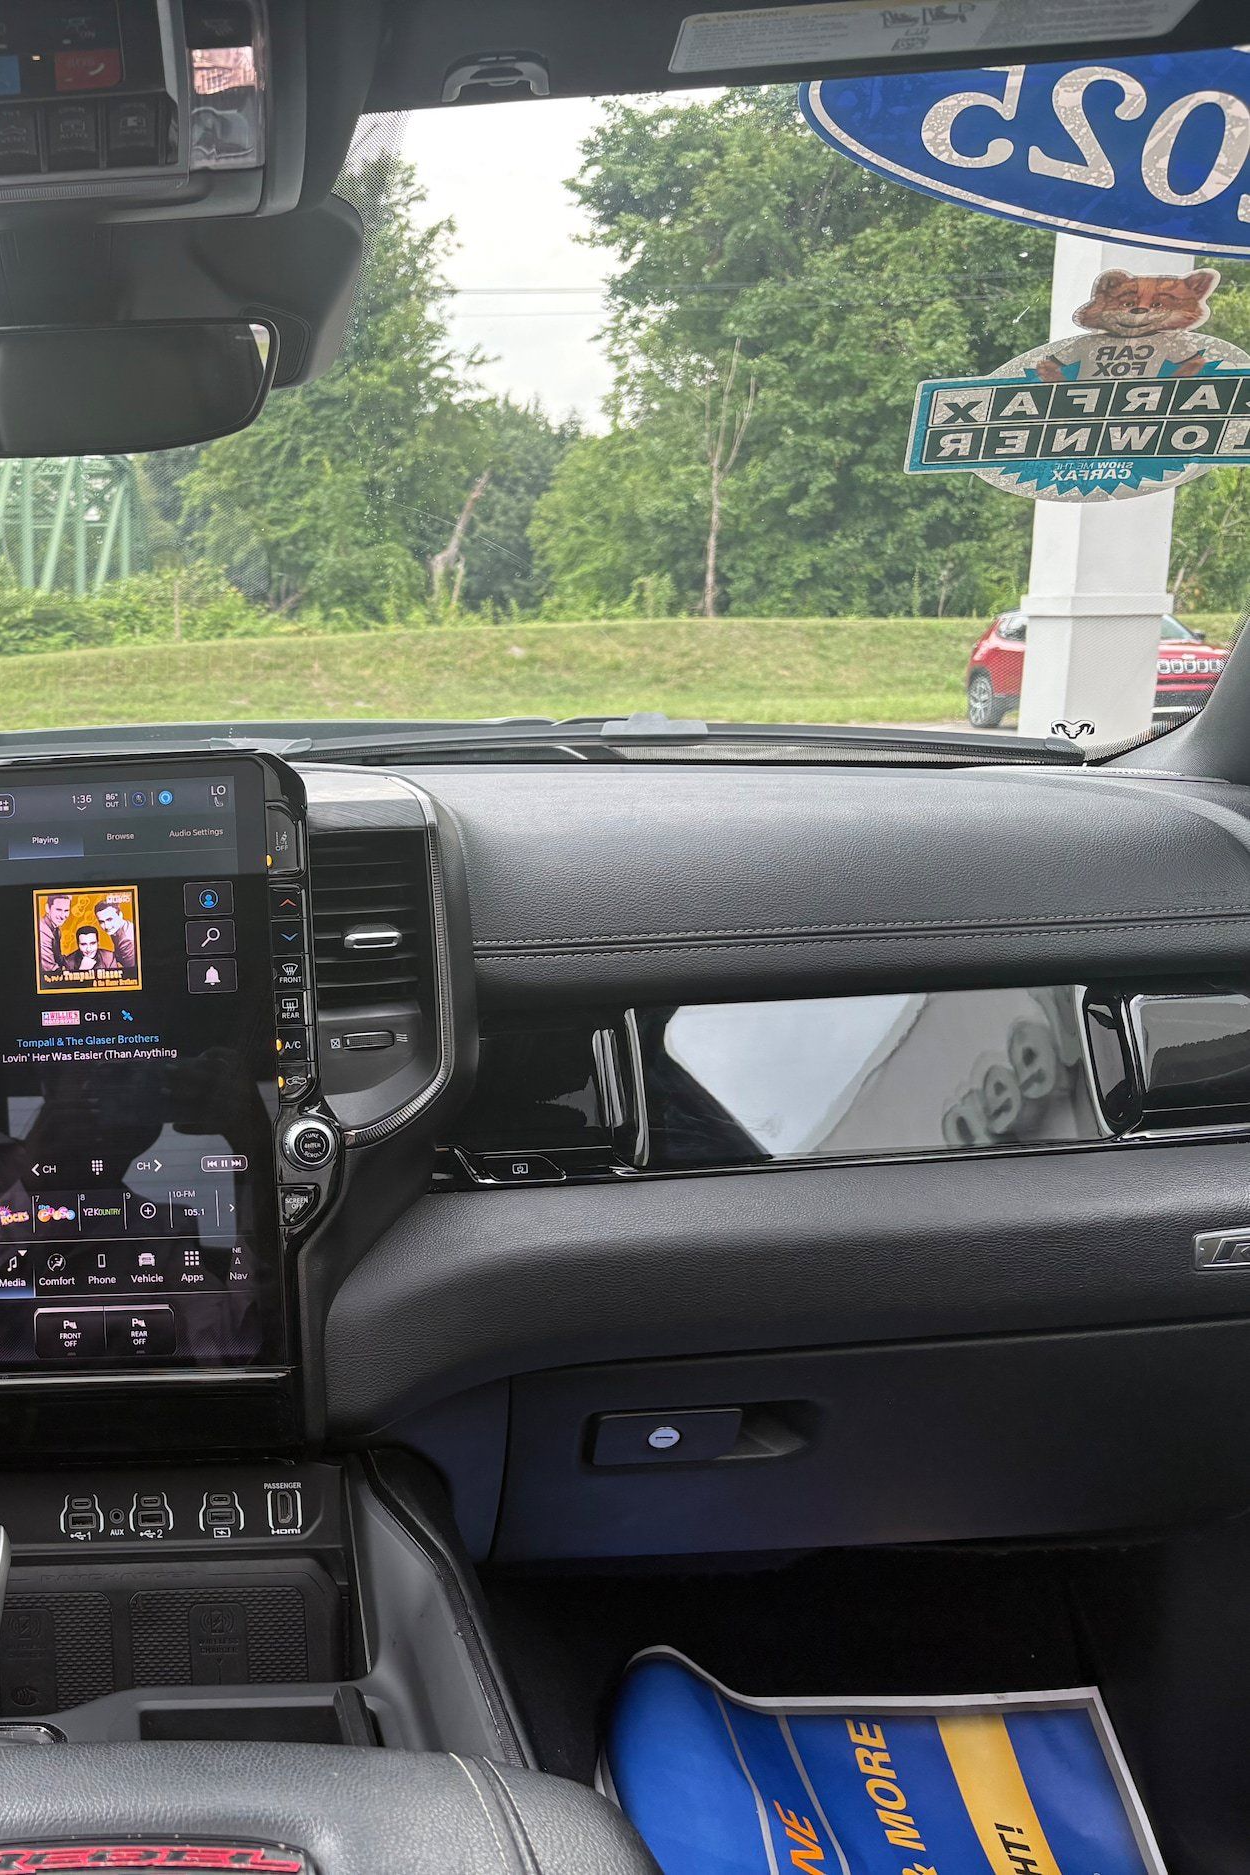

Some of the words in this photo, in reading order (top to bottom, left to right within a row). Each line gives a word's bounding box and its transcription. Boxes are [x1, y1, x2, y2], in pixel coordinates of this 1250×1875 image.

[211, 785, 226, 796] LO
[71, 794, 92, 805] 1:36
[106, 832, 135, 841] Browse
[169, 828, 191, 838] Audio
[192, 827, 224, 839] Settings
[32, 835, 59, 846] Playing
[63, 969, 95, 982] Tompall
[84, 1012, 99, 1021] Ch
[100, 1012, 111, 1021] 61
[16, 1038, 55, 1049] Tompall
[57, 1038, 65, 1047] &
[65, 1037, 83, 1046] The
[85, 1035, 115, 1045] Glaser
[118, 1034, 160, 1044] Brothers
[284, 1041, 301, 1049] A/C
[2, 1053, 31, 1063] Lovin'
[32, 1053, 50, 1062] Her
[51, 1052, 72, 1061] Was
[74, 1051, 103, 1061] Easier
[104, 1049, 132, 1060] (Than
[133, 1048, 178, 1060] Anything
[42, 1165, 57, 1174] CH
[136, 1161, 151, 1171] CH
[172, 1190, 196, 1198] 10-FM
[183, 1208, 205, 1217] 105.1
[0, 1211, 30, 1226] ROCKS
[38, 1276, 76, 1286] Comfort
[88, 1275, 117, 1285] Phone
[130, 1273, 164, 1284] Vehicle
[180, 1273, 204, 1284] Apps
[229, 1271, 248, 1281] Nav
[263, 1481, 302, 1490] PASSENGER
[86, 1531, 92, 1540] 1
[156, 1530, 163, 1539] 2
[845, 1718, 927, 1852] MORE
